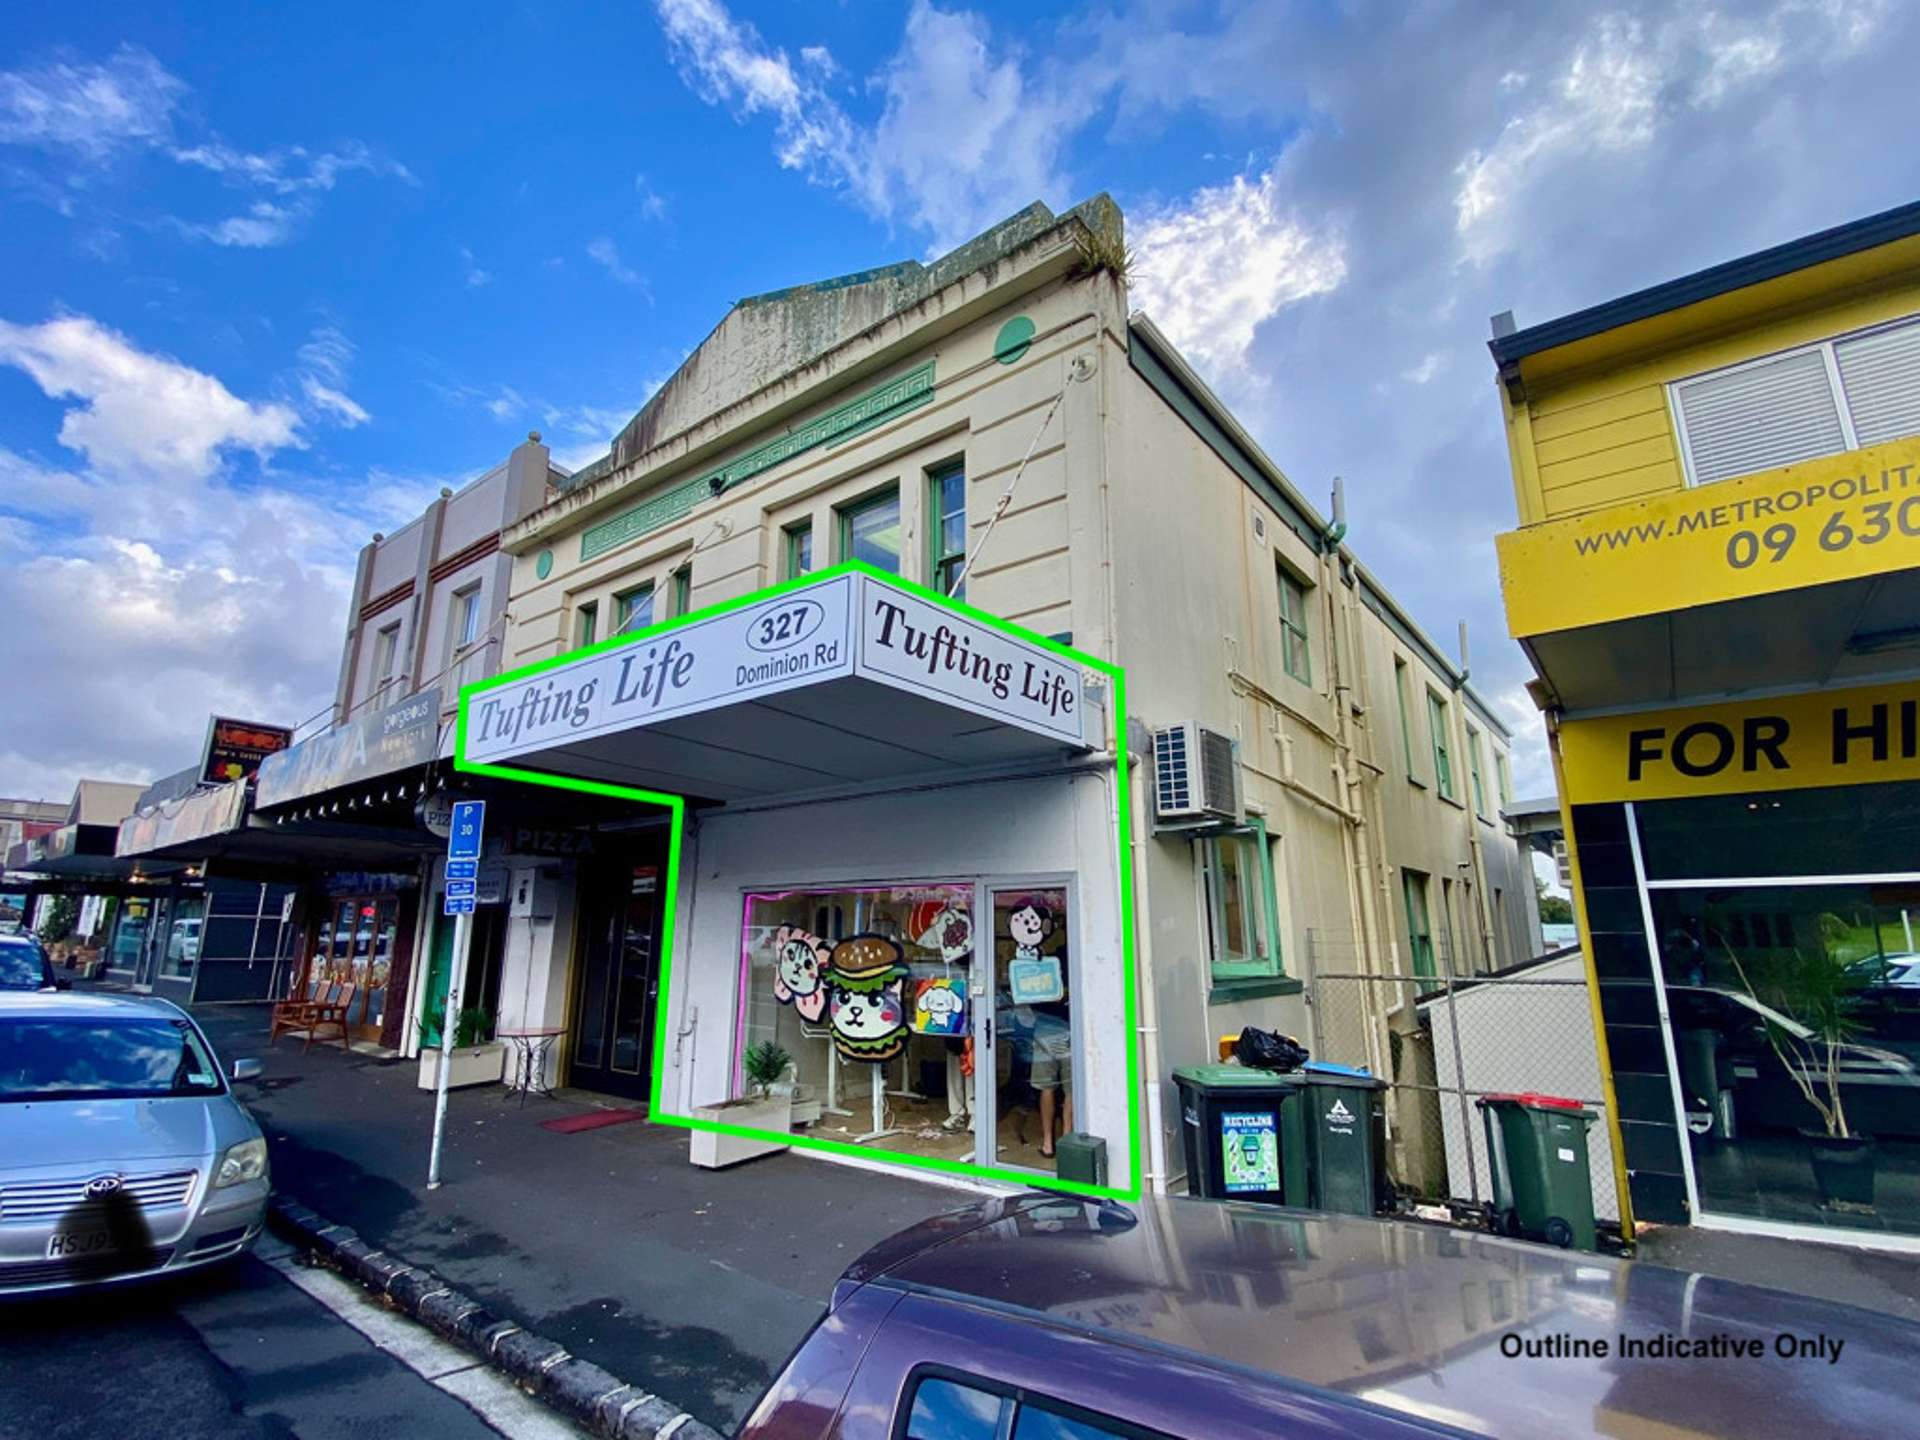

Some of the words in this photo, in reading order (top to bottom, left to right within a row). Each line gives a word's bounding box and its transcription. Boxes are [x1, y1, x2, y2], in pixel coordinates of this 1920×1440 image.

[1575, 463, 1920, 556] WWW.METROPOLIT
[1726, 521, 1797, 570] 09
[1818, 495, 1920, 553] 630
[760, 607, 807, 645] 327
[736, 652, 810, 687] Dominion
[814, 639, 838, 673] Rd
[874, 599, 1013, 700] Tufting
[1020, 661, 1075, 717] Life
[477, 677, 599, 744] Tufting
[611, 640, 695, 708] Life
[1628, 716, 1791, 781] FOR
[1832, 701, 1917, 764] HI
[428, 811, 450, 825] PIZ
[460, 824, 473, 836] 30
[463, 806, 473, 818] P
[515, 831, 595, 855] PIZZA
